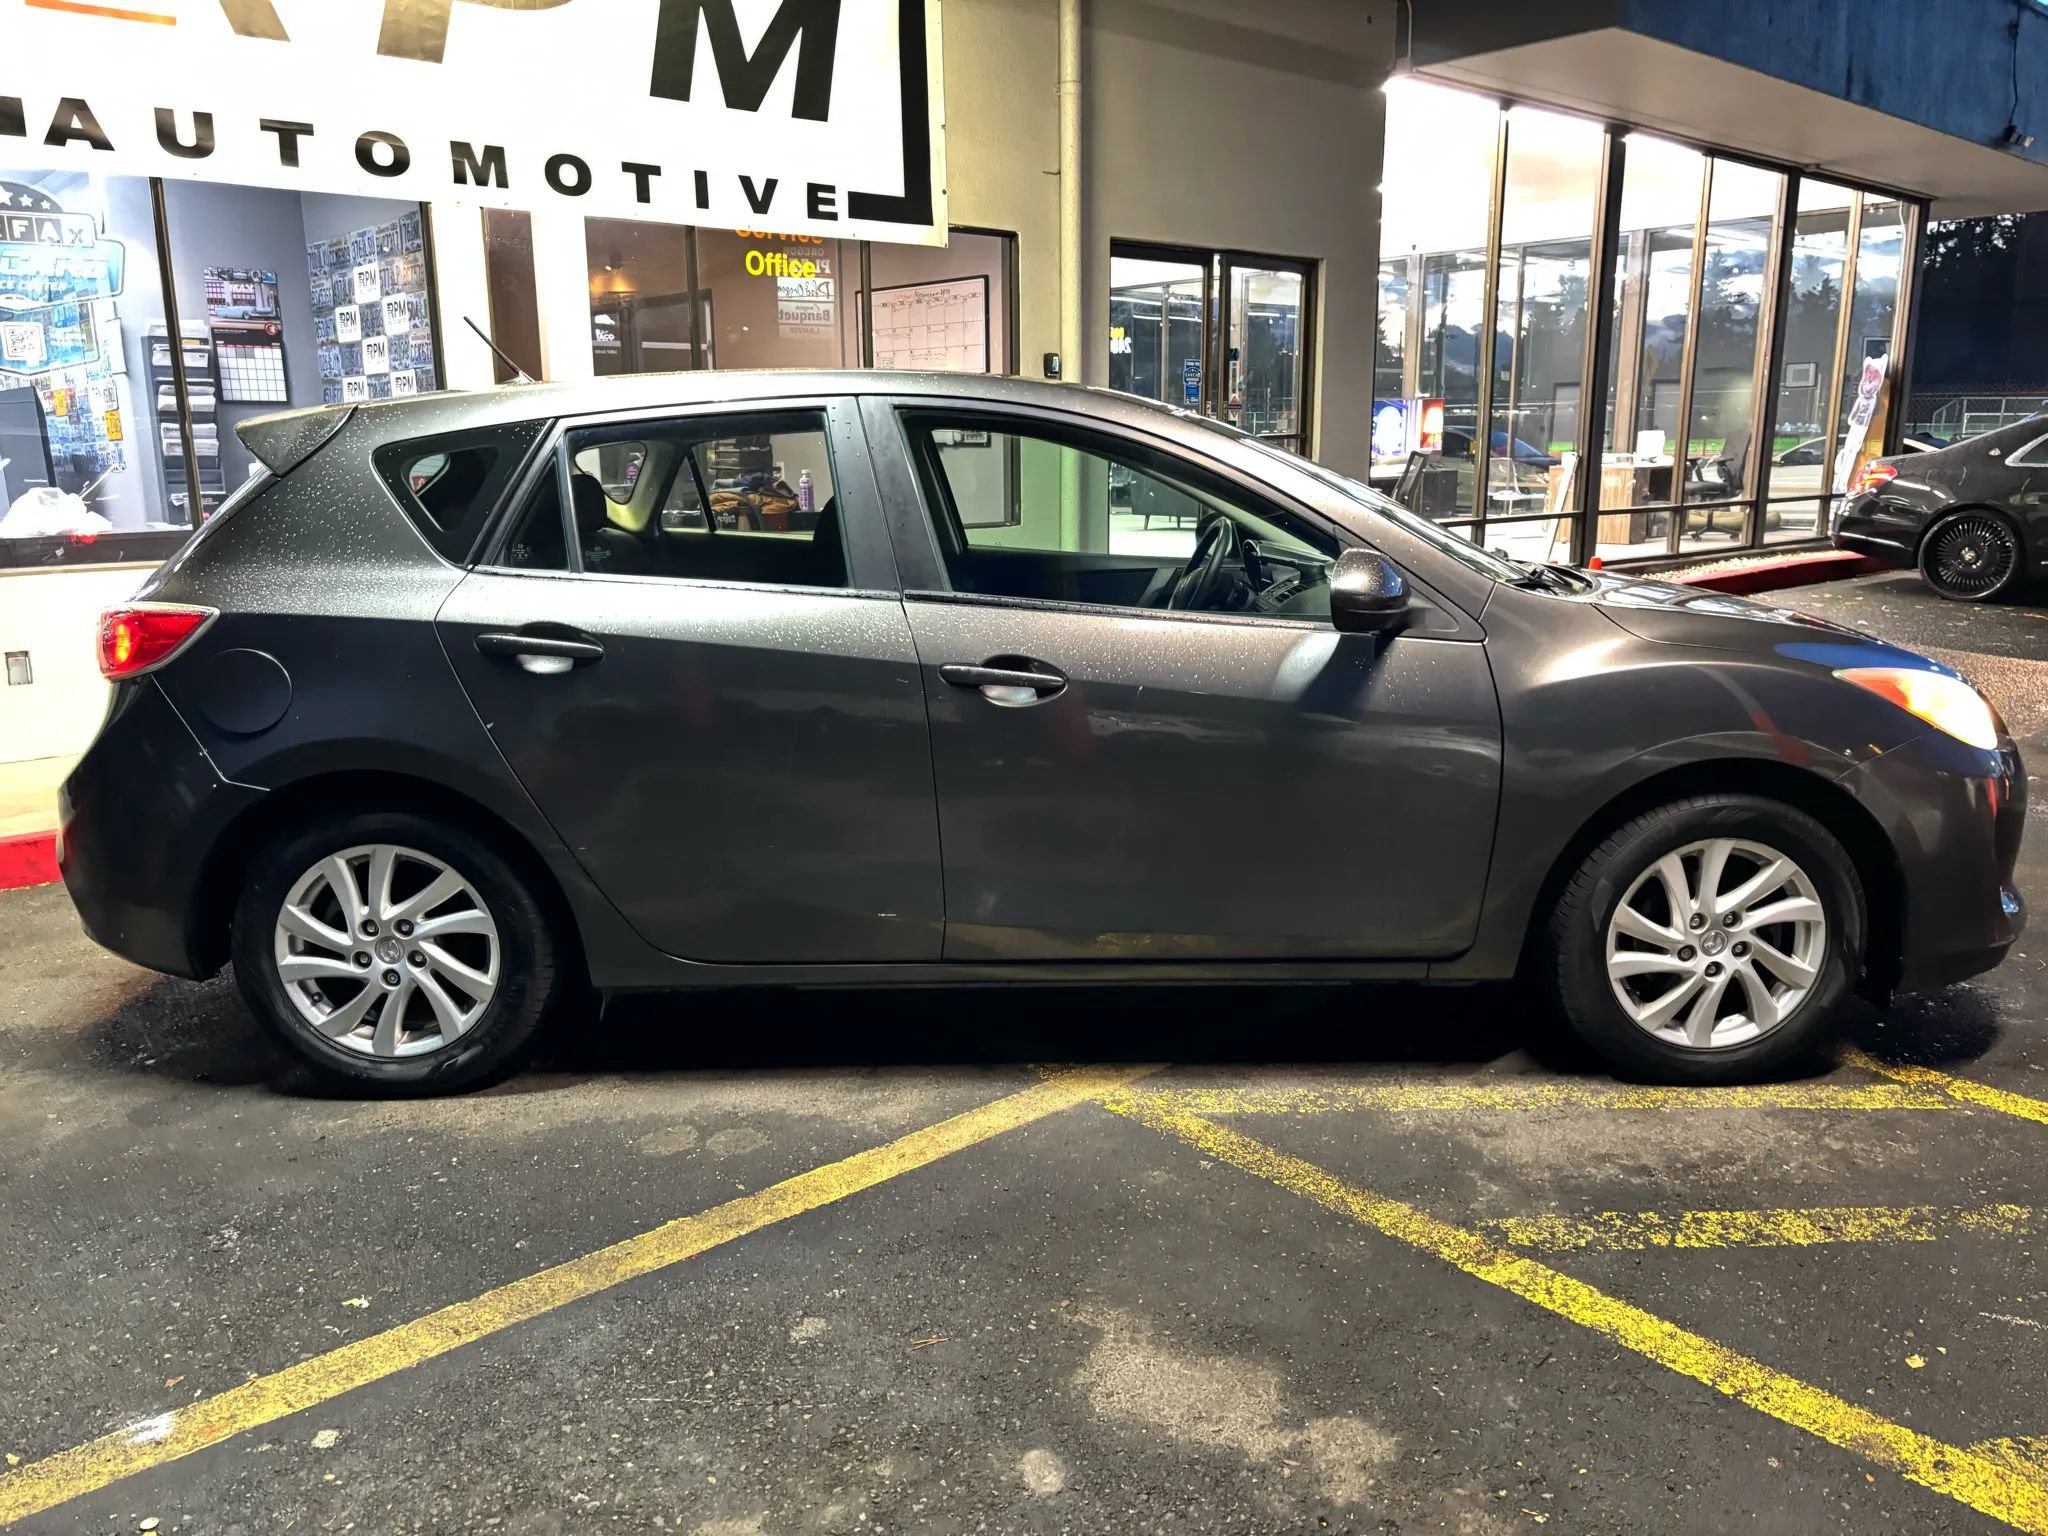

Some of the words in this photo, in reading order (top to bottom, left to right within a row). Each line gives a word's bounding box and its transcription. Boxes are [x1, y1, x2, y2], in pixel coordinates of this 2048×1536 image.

[44, 97, 839, 222] AUTOMOTIVE
[0, 218, 84, 245] FAX
[745, 250, 816, 279] Office
[358, 268, 377, 288] RPM
[339, 310, 357, 328] RPM
[387, 299, 407, 319] RPM
[366, 341, 385, 360] RPM
